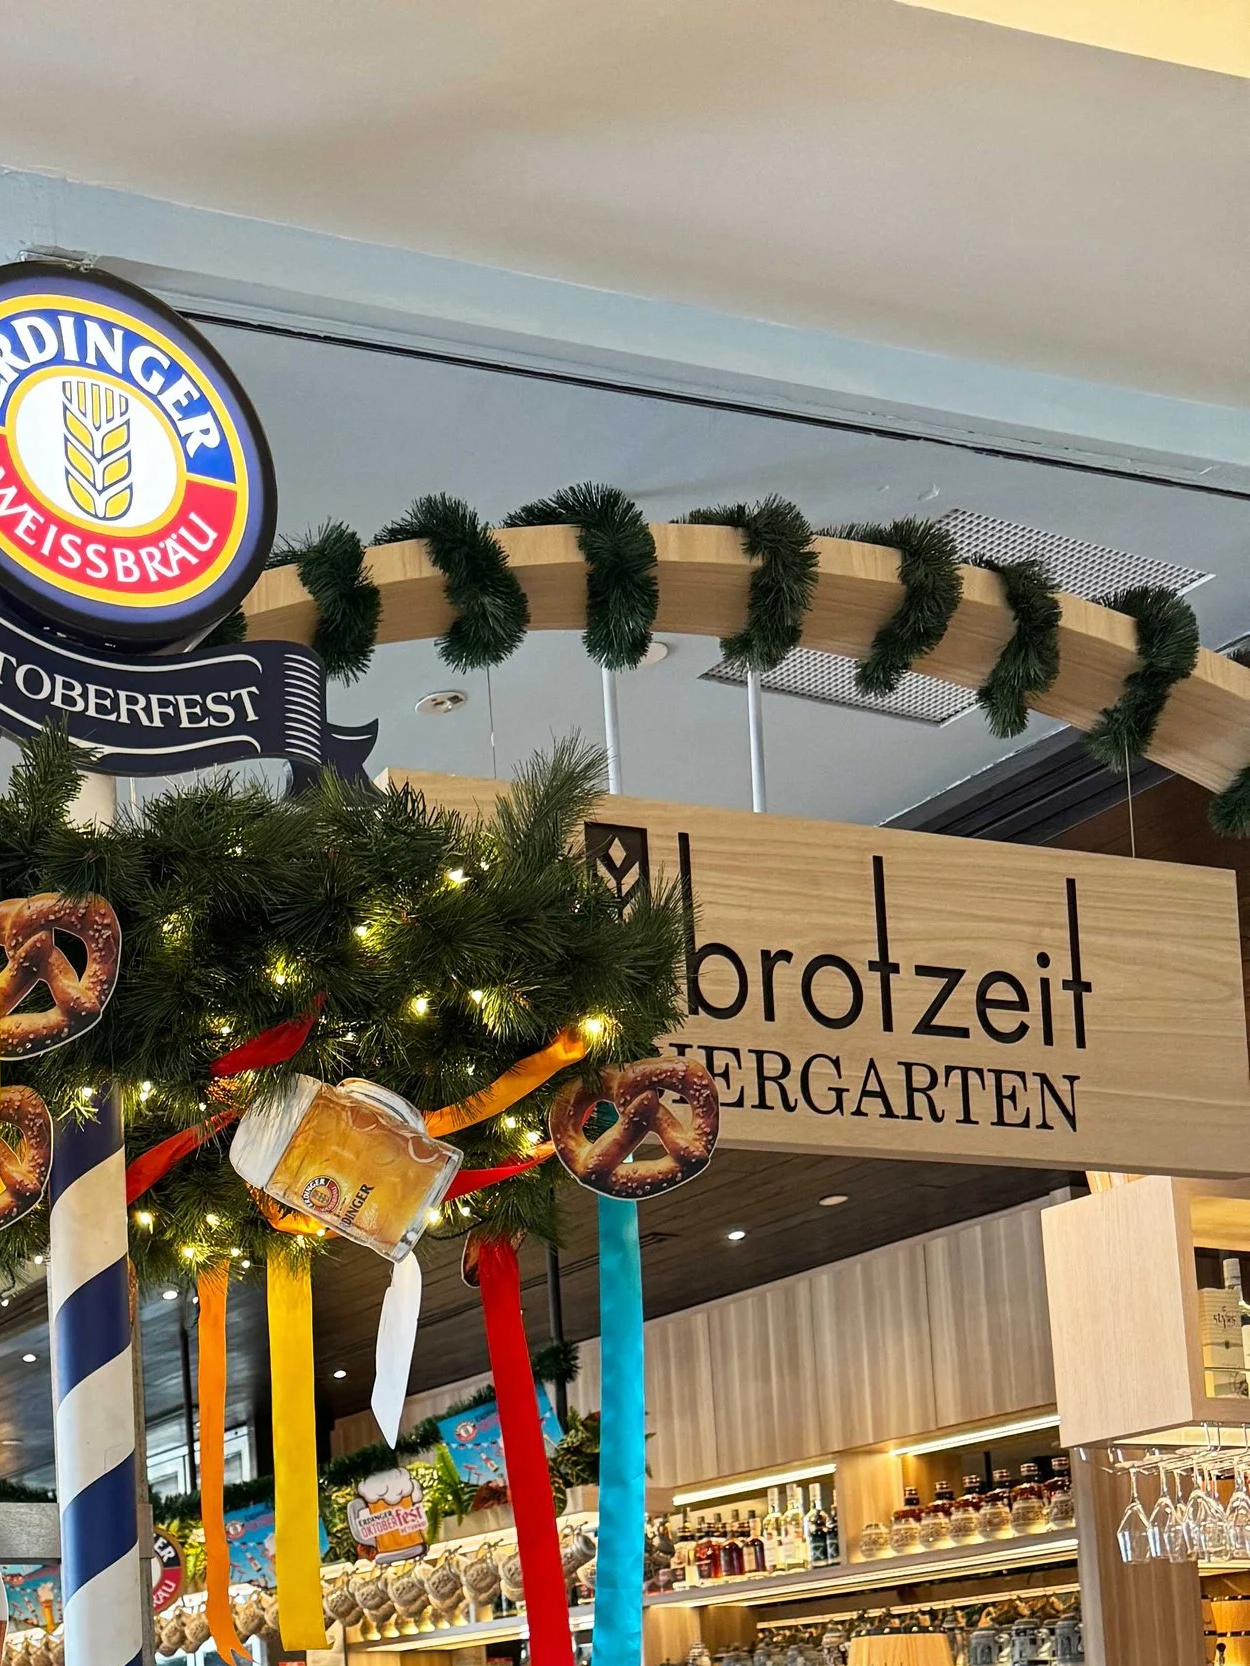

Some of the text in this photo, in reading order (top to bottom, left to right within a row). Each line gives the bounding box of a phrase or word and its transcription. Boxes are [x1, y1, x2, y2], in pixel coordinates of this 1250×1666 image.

[678, 832, 1092, 1049] brotzeit
[655, 1042, 1081, 1133] ERGARTEN
[340, 1184, 376, 1229] DINGER
